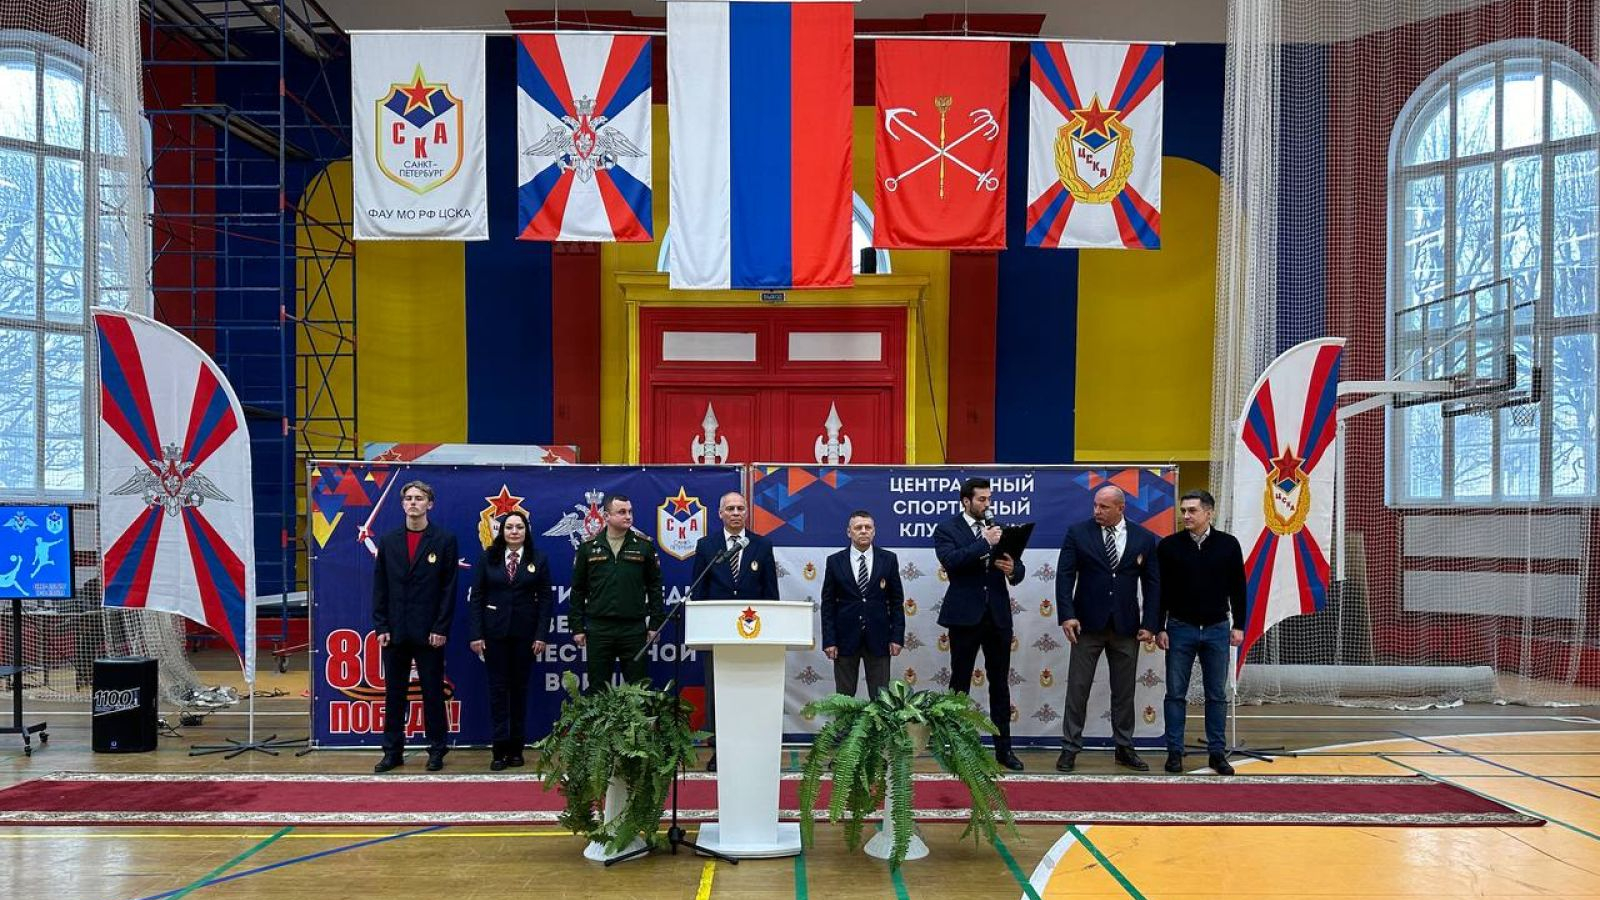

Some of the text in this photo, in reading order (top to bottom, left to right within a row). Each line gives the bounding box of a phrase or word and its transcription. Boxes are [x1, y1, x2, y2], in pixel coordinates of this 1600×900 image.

[393, 122, 448, 158] СКА
[1078, 147, 1107, 177] ЦСКА
[399, 169, 444, 177] ПЕТЕРБУРГ
[368, 208, 472, 220] ФАУ МО РФ ЦСКА
[890, 474, 1034, 493] ЦЕНТРАНЫЙ
[893, 497, 1031, 515] СПОРТНЫЙ
[666, 518, 698, 539] СКА
[900, 523, 938, 538] КЛУ
